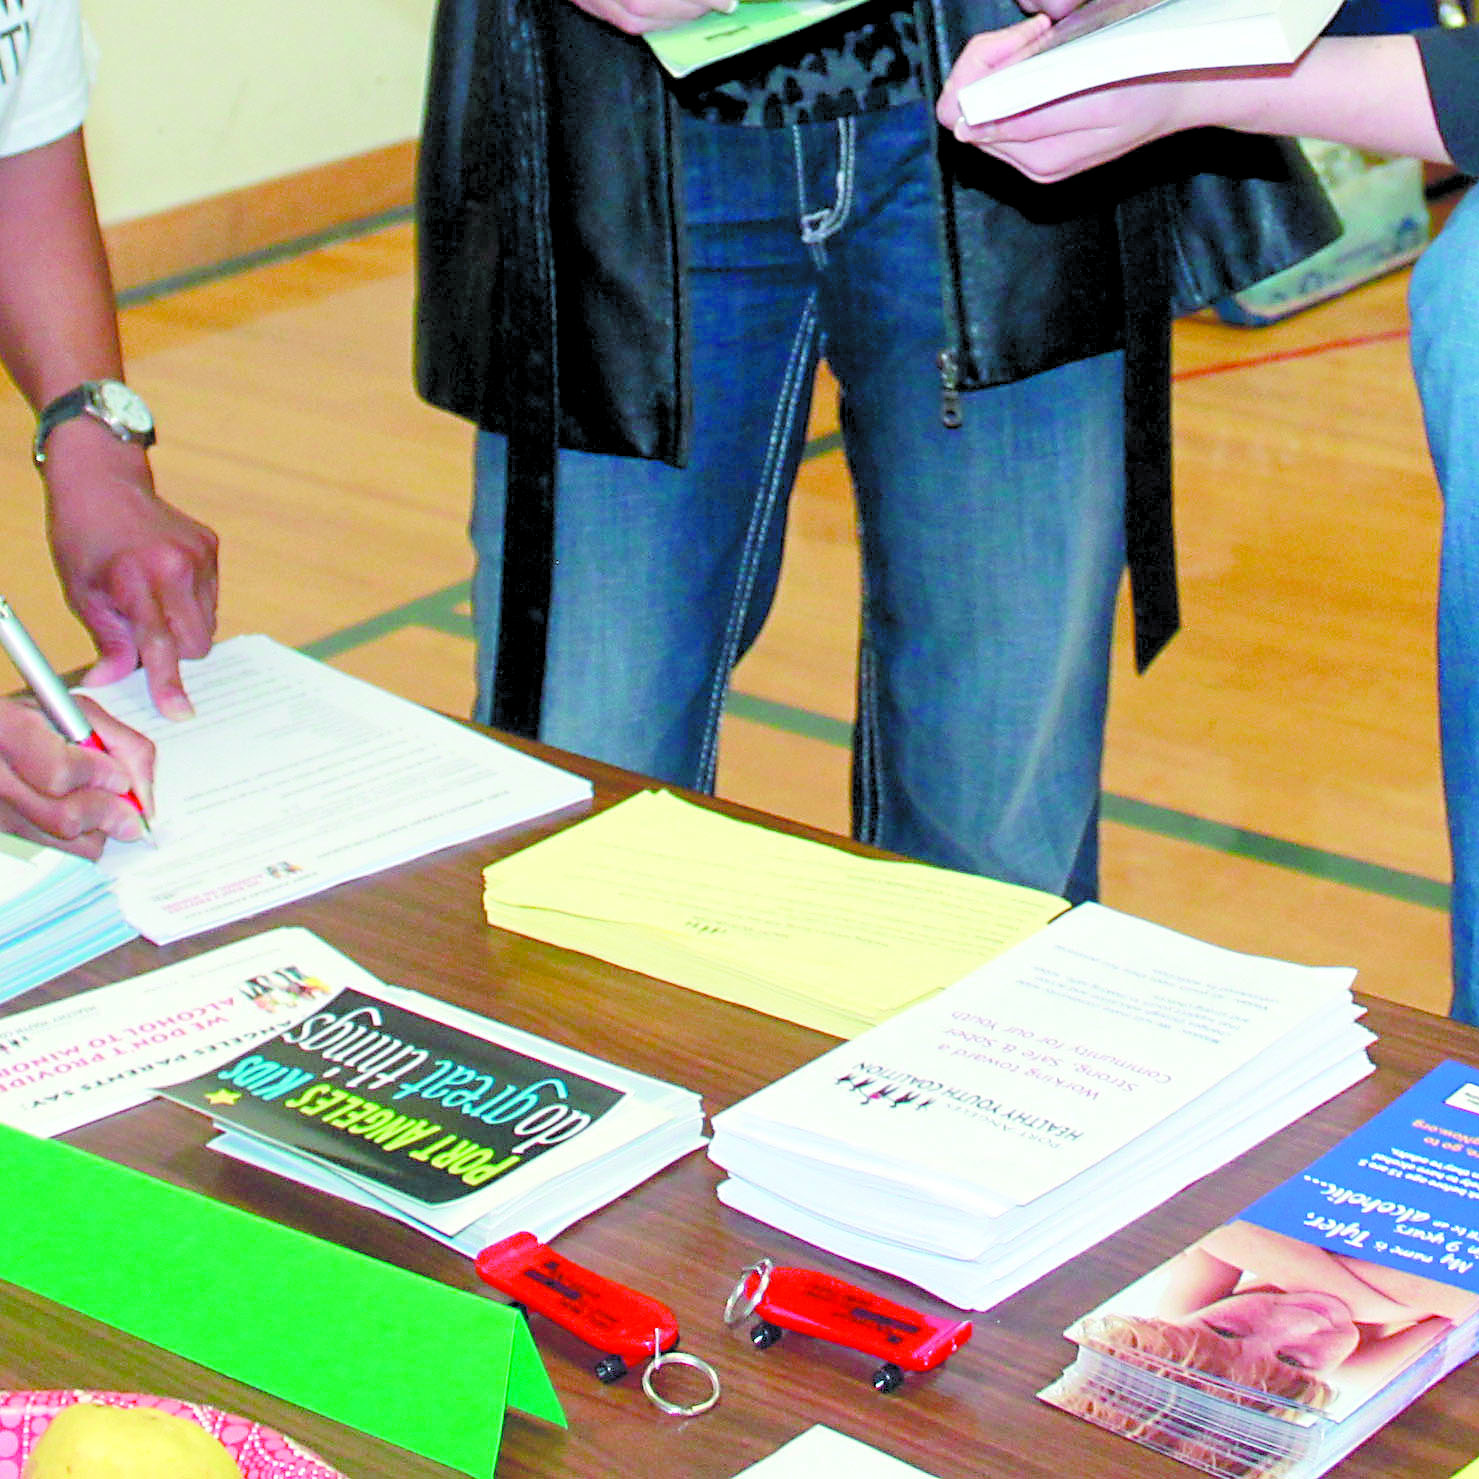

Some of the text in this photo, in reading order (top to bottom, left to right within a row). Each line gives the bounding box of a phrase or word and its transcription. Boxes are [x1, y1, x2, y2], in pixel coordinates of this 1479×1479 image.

[123, 995, 236, 1036] ALCOHOL
[193, 1014, 232, 1033] WE
[85, 1031, 120, 1049] TO
[110, 1027, 188, 1059] DON'T
[192, 1019, 293, 1060] ANGELES
[943, 1028, 999, 1049] Sober
[1001, 1026, 1035, 1040] our
[1034, 1036, 1066, 1050] for
[1001, 1043, 1018, 1055] &
[1020, 1049, 1064, 1068] Safe
[949, 1047, 1021, 1074] toward
[1069, 1044, 1173, 1085] Community
[82, 1052, 188, 1093] PARENTS
[283, 1006, 592, 1156] do great things
[1023, 1067, 1100, 1102] Working
[851, 1061, 1085, 1143] HEALTHY YOUTH COALITION
[216, 1054, 521, 1188] PORT ANGELES KIDS
[1422, 1136, 1442, 1148] to
[1440, 1141, 1465, 1154] go
[1373, 1239, 1389, 1253] is
[1388, 1244, 1434, 1264] name
[1444, 1239, 1464, 1253] 9
[1438, 1252, 1474, 1275] My
